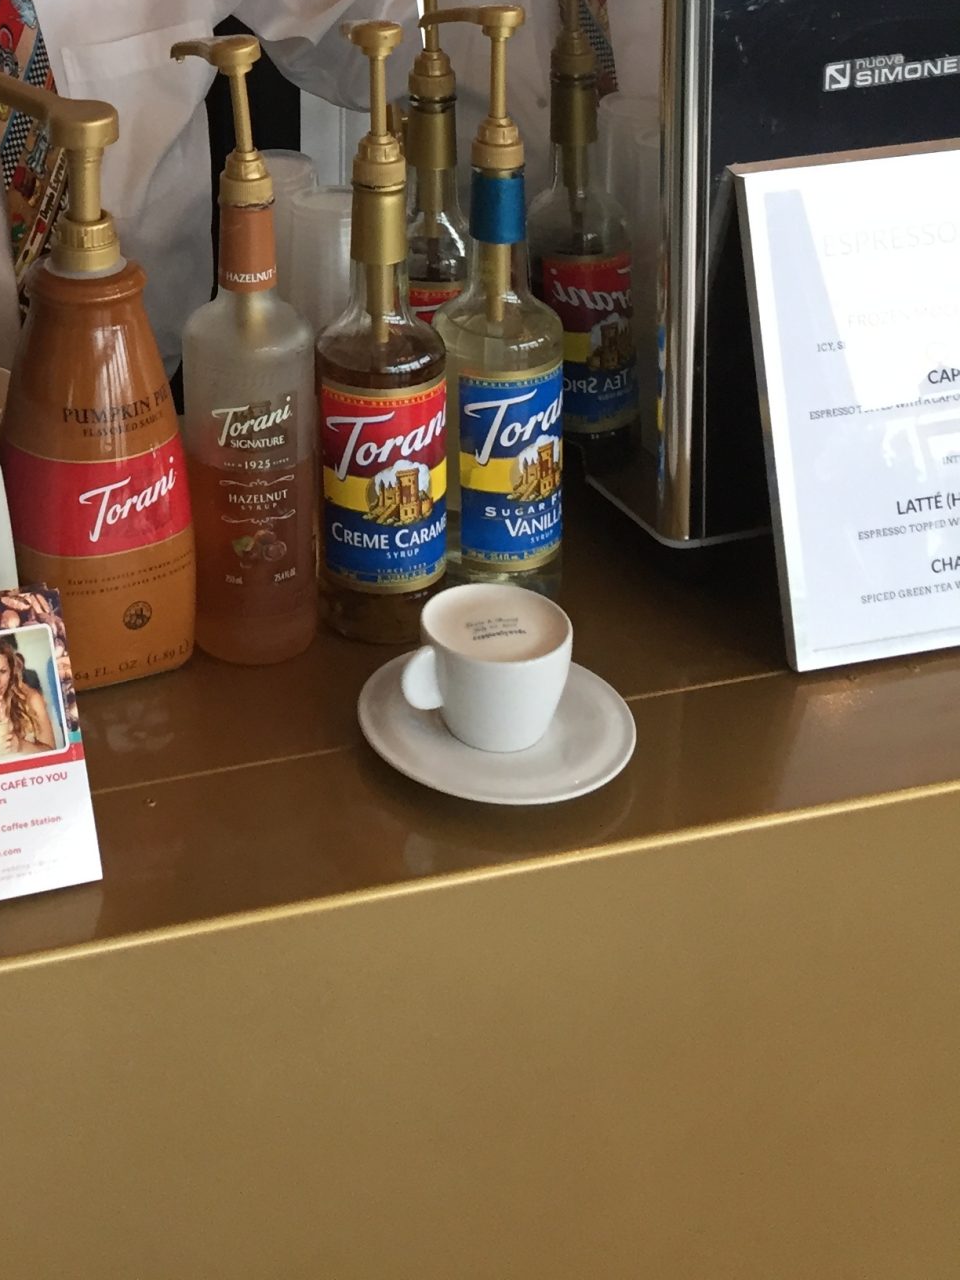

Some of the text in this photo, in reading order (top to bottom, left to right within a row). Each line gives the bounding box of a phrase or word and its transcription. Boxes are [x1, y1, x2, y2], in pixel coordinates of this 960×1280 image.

[856, 53, 904, 69] nuova
[856, 59, 958, 86] SIMONE
[226, 268, 273, 283] HAZELNUT
[63, 397, 152, 425] PUMPKIN
[809, 406, 856, 420] ESPRESSO
[212, 396, 292, 447] Torani
[230, 435, 286, 449] SIGNATURE
[245, 459, 271, 470] 1925
[79, 456, 177, 542] Torani
[228, 488, 289, 504] HAZELNUT
[896, 492, 943, 515] LATTÉ
[240, 501, 278, 511] SYRUP
[485, 502, 545, 518] SUGAR
[331, 522, 389, 549] CREME
[858, 525, 907, 540] ESPRESSO
[909, 519, 946, 533] TOPPED
[386, 547, 420, 559] SYRUP
[861, 591, 896, 605] SPICED
[898, 585, 932, 599] GREEN
[934, 582, 953, 594] TEA
[73, 670, 90, 681] 64
[118, 659, 138, 672] OZ
[0, 777, 28, 791] CAFÉ
[29, 775, 44, 786] TO
[46, 771, 69, 783] YOU
[1, 821, 28, 833] Coffee
[31, 816, 61, 827] Station
